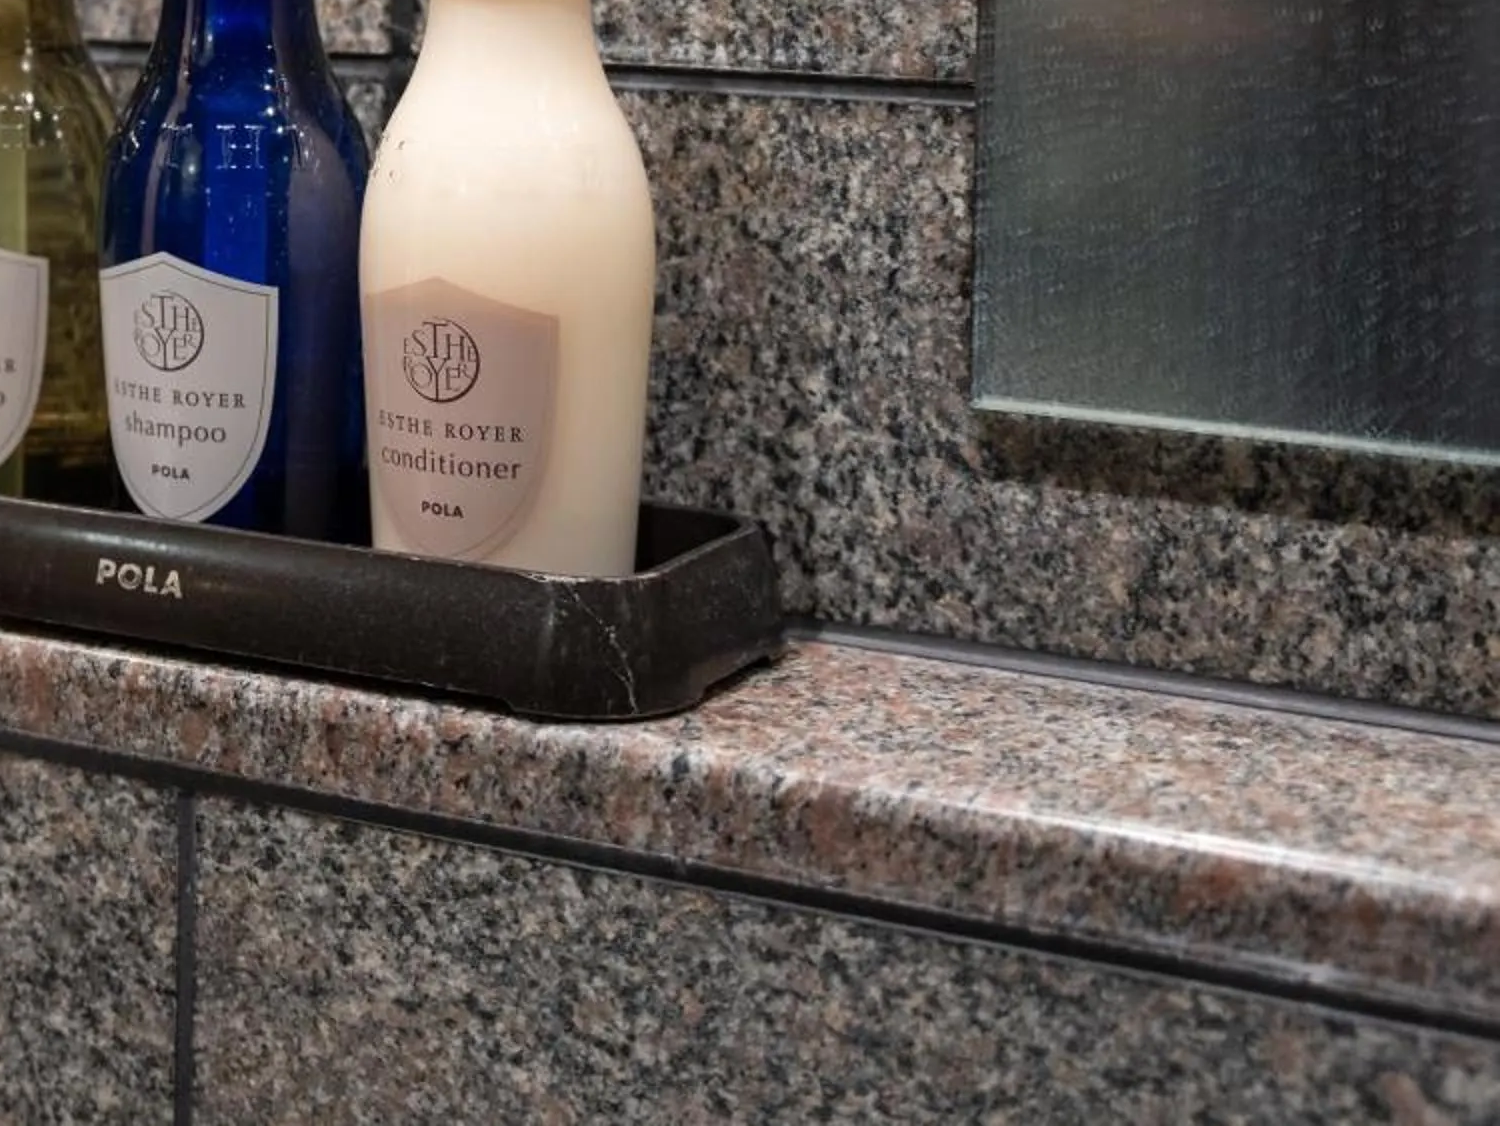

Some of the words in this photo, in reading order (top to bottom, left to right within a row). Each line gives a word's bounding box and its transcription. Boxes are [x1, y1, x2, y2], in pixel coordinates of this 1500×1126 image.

[172, 389, 246, 409] ROYER
[125, 410, 227, 448] shampoo
[378, 409, 433, 437] ESTHE
[444, 422, 524, 443] ROYER
[151, 463, 190, 480] POLA
[381, 447, 522, 480] conditioner
[421, 500, 464, 519] POLA
[95, 557, 183, 599] POLA
